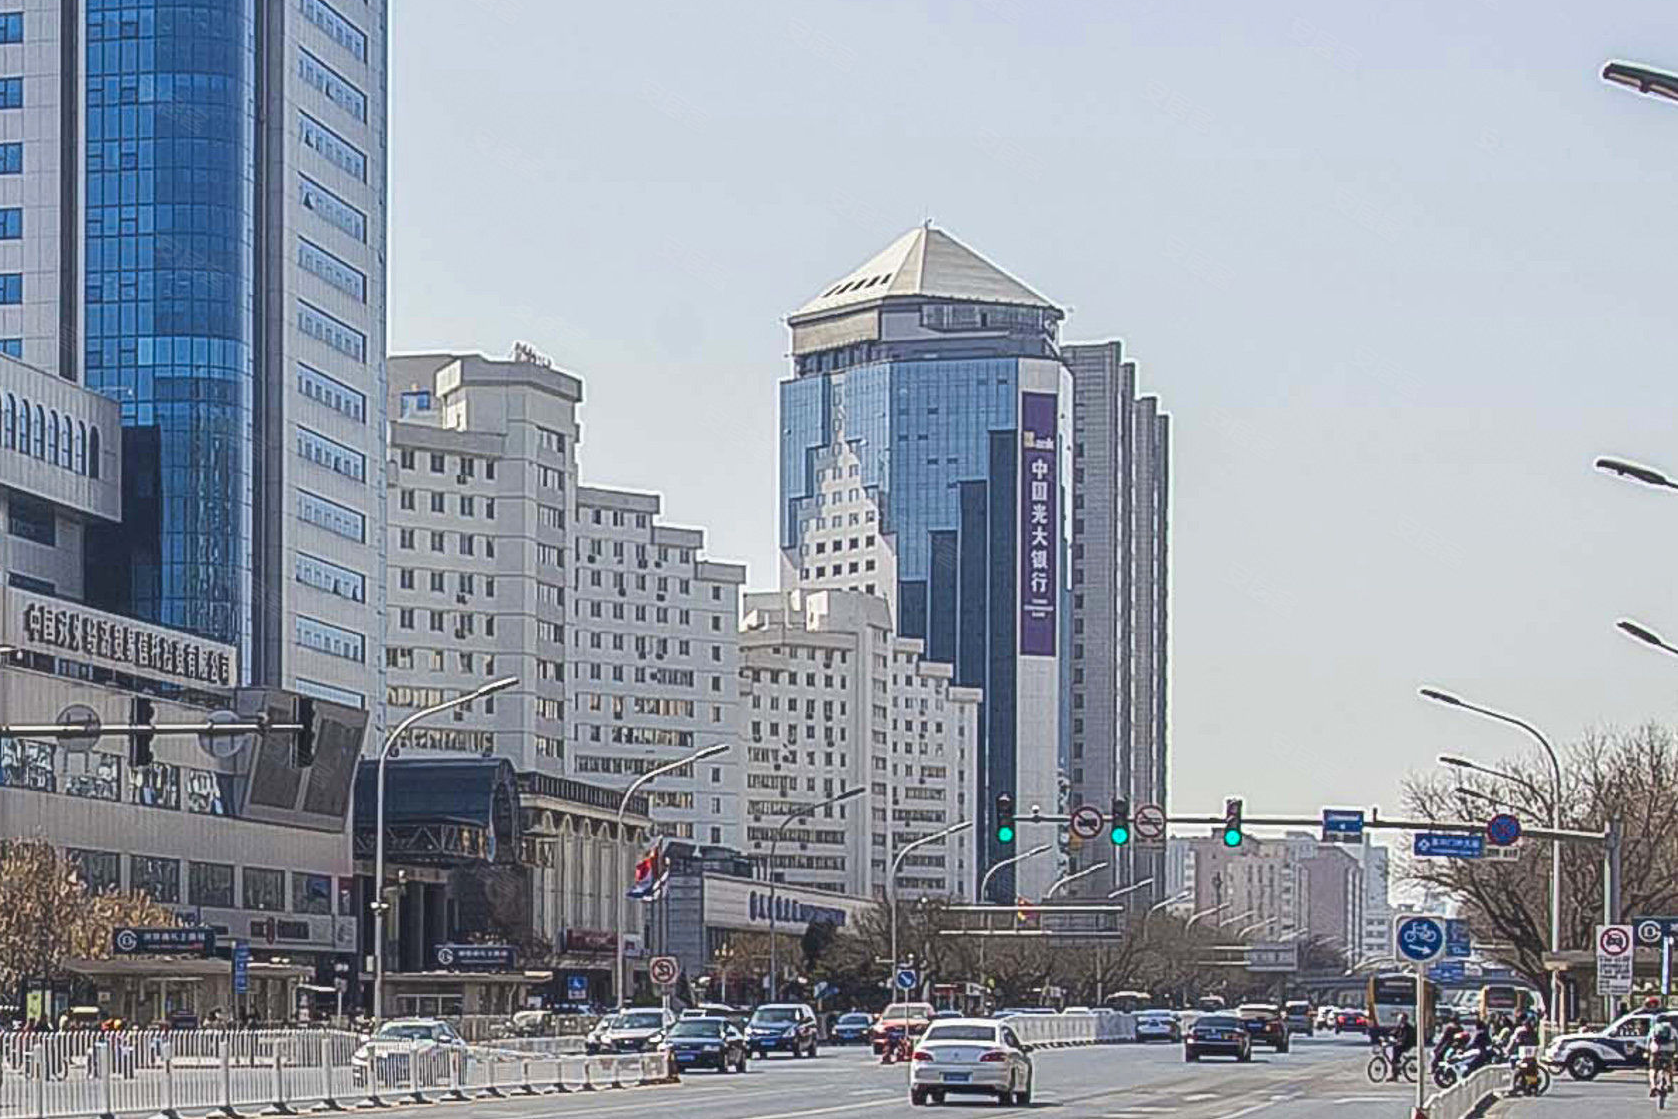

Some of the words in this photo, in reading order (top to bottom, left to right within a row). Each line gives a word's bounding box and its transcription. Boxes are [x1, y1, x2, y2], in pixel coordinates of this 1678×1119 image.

[1031, 458, 1049, 593] 中国光大银行
